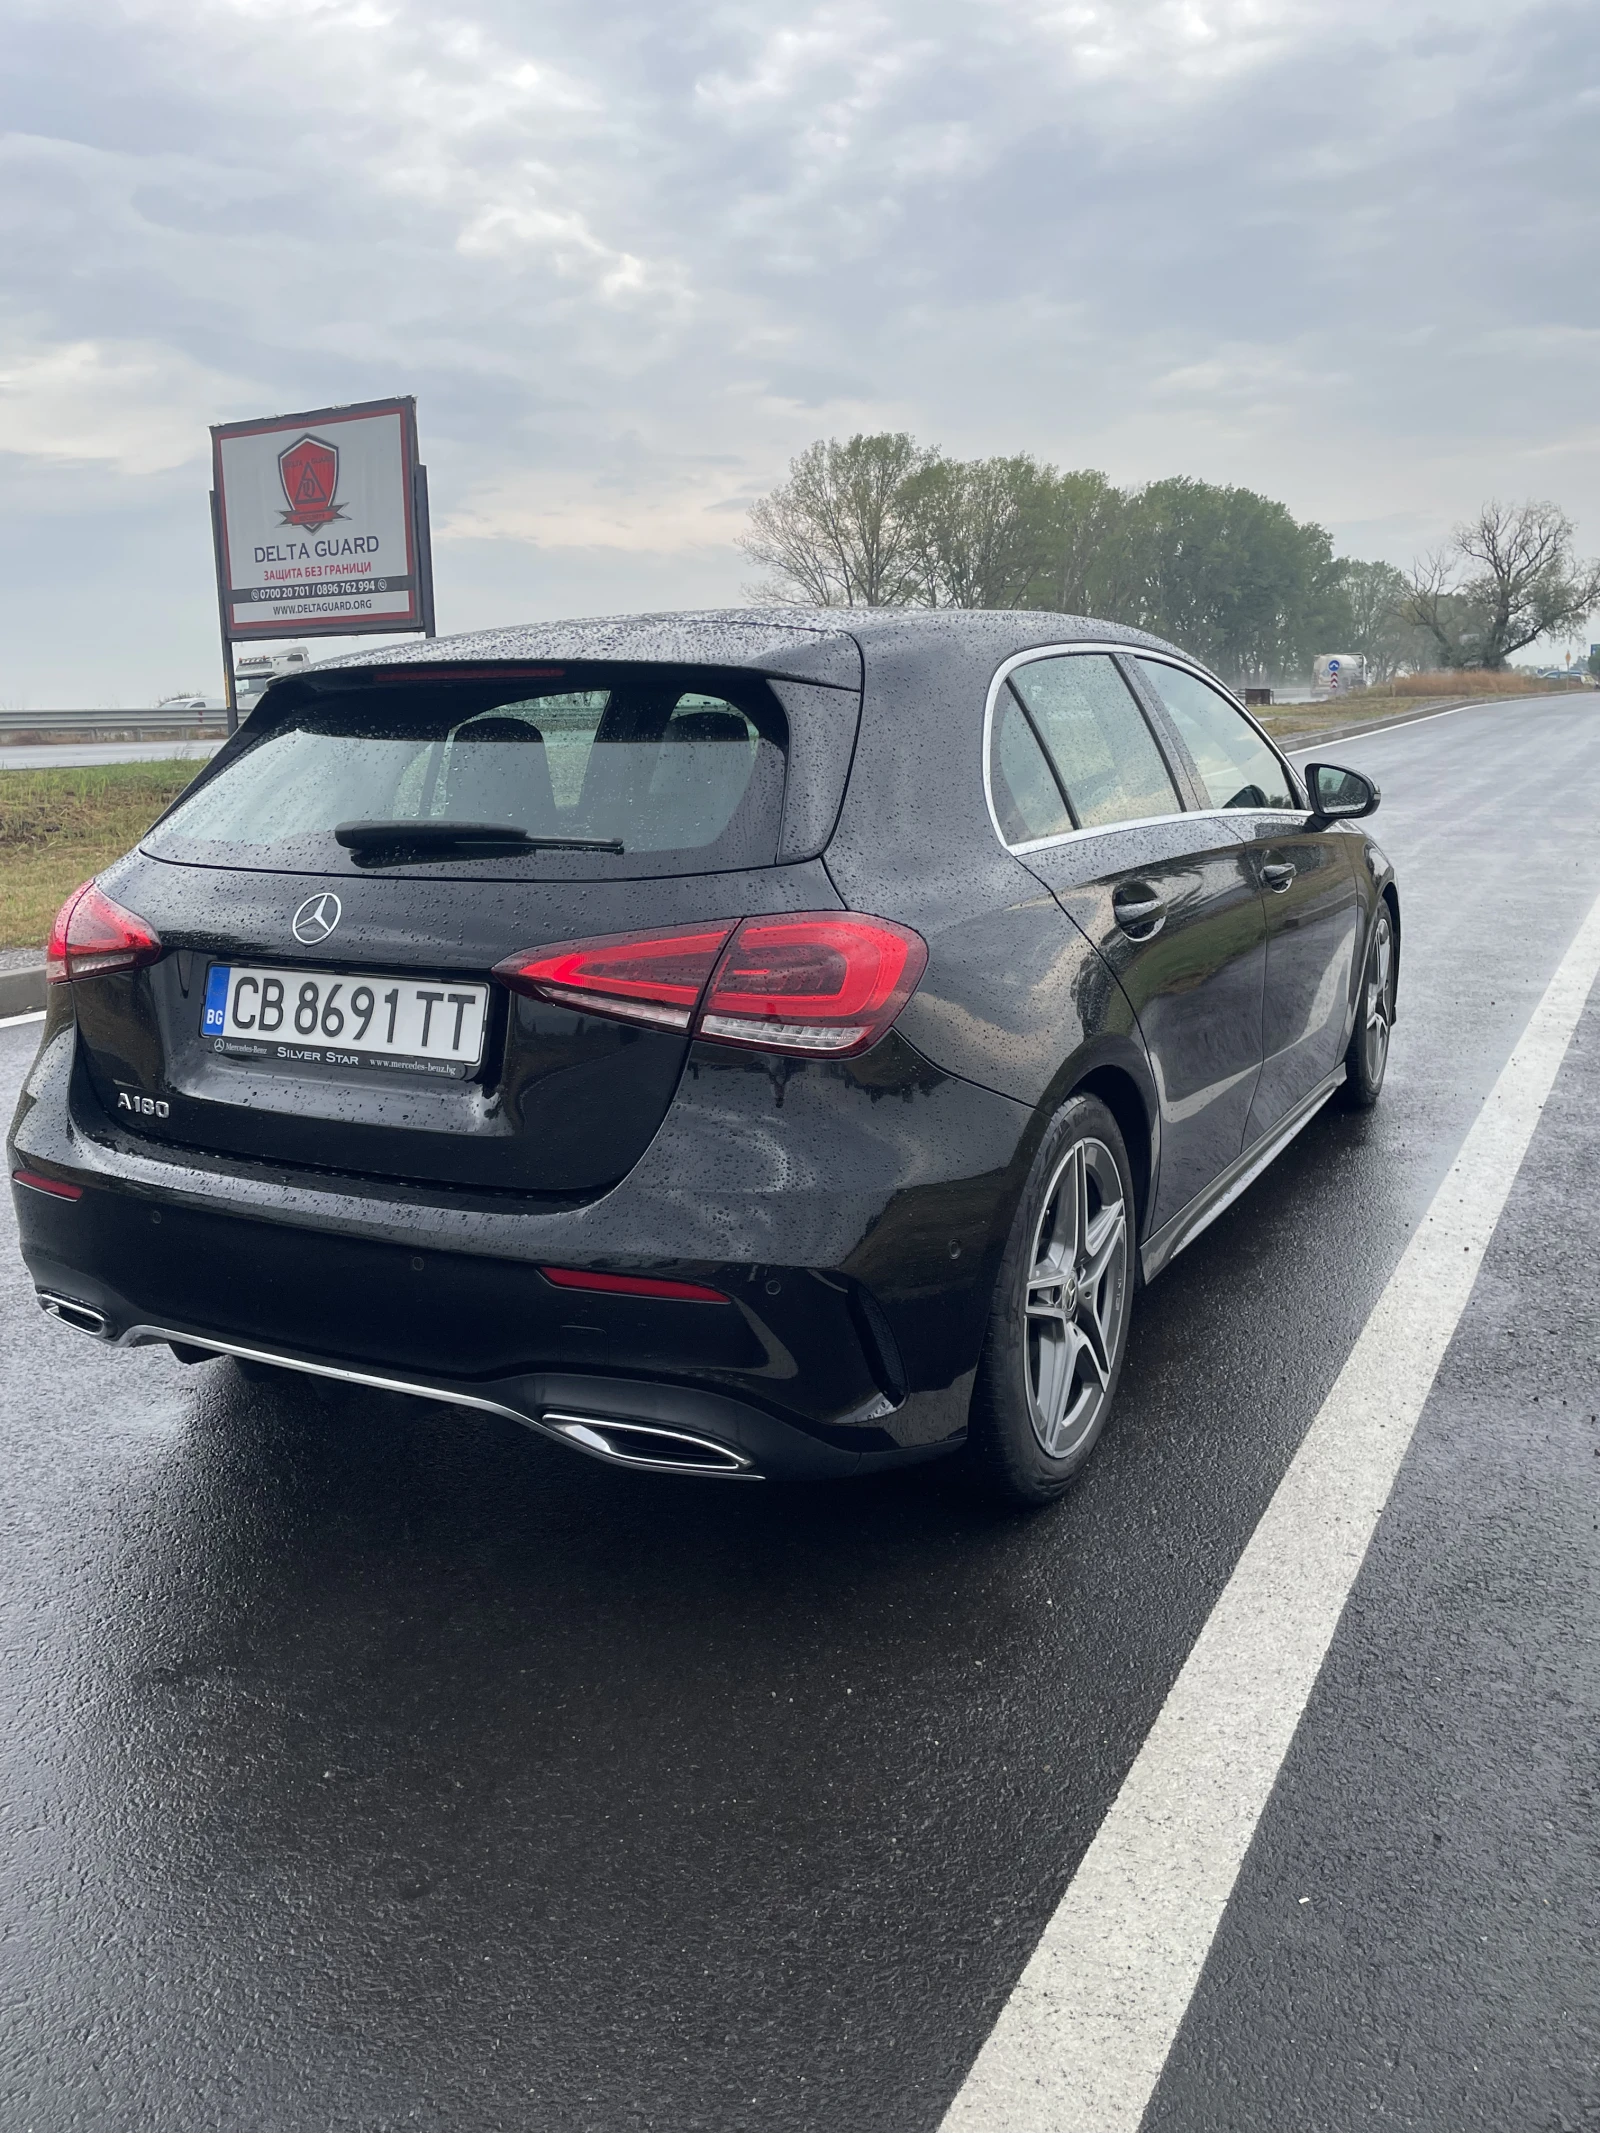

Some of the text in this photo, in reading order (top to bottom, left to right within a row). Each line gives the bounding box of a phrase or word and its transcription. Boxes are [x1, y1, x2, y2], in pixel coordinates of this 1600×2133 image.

[254, 535, 380, 563] DELTA GUARD
[263, 562, 372, 582] ЗАЩИТА БЕЗ ГРАНИЦИ
[260, 588, 281, 600] 0700
[282, 587, 293, 598] 20
[294, 586, 310, 597] 701
[316, 583, 339, 596] 0896
[340, 582, 357, 594] 762
[358, 580, 376, 592] 994
[273, 599, 372, 616] WWW.DELTAGUARD.ORG
[206, 1008, 223, 1025] BG
[231, 976, 476, 1051] CB 8691 TT
[225, 1042, 457, 1076] Mercedes-Benz SILVER STAR www.mercedes-benz.bg
